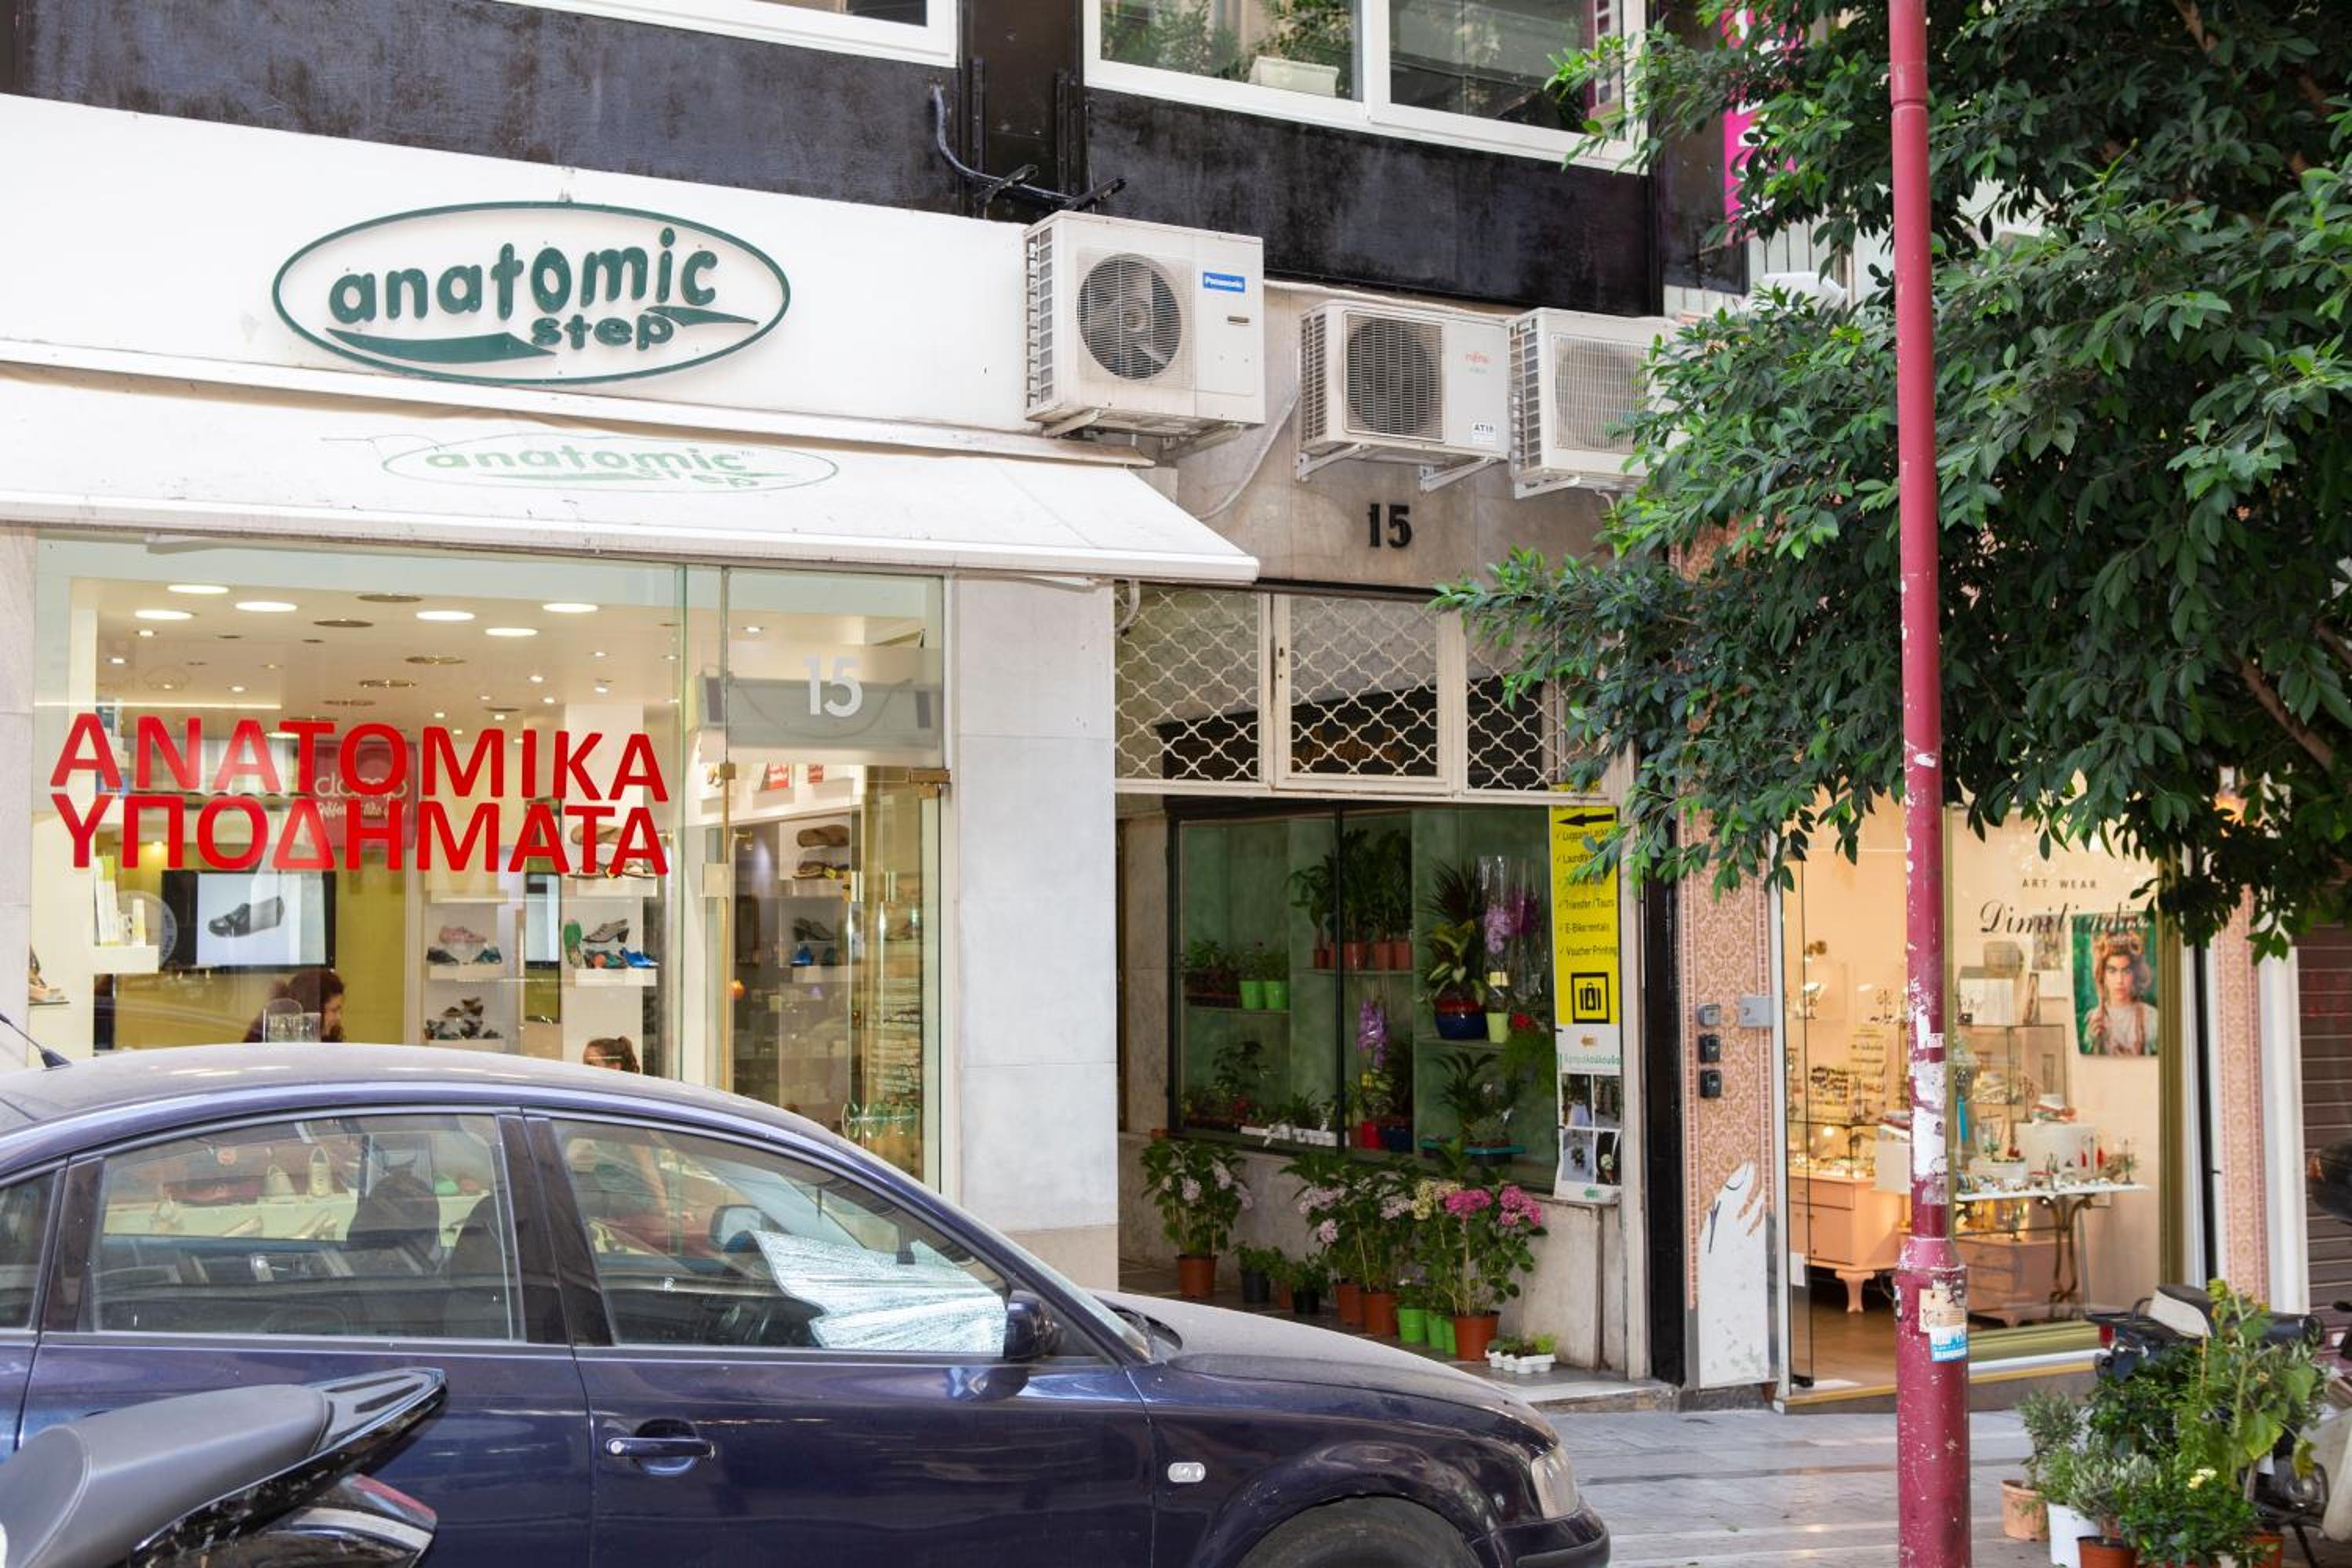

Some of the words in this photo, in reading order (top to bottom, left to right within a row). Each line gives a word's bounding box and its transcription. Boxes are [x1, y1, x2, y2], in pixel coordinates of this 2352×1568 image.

[328, 227, 719, 325] anatomic
[531, 314, 674, 351] step
[425, 445, 745, 472] anatomic
[1367, 503, 1412, 549] 15
[804, 653, 863, 717] 15
[50, 713, 669, 803] ΑΝΑΤΟΜΙΚΑ
[50, 793, 669, 875] ΥΠΟΔΗΜΑΤΑ
[2022, 878, 2049, 888] ART
[2060, 880, 2097, 889] WEAR
